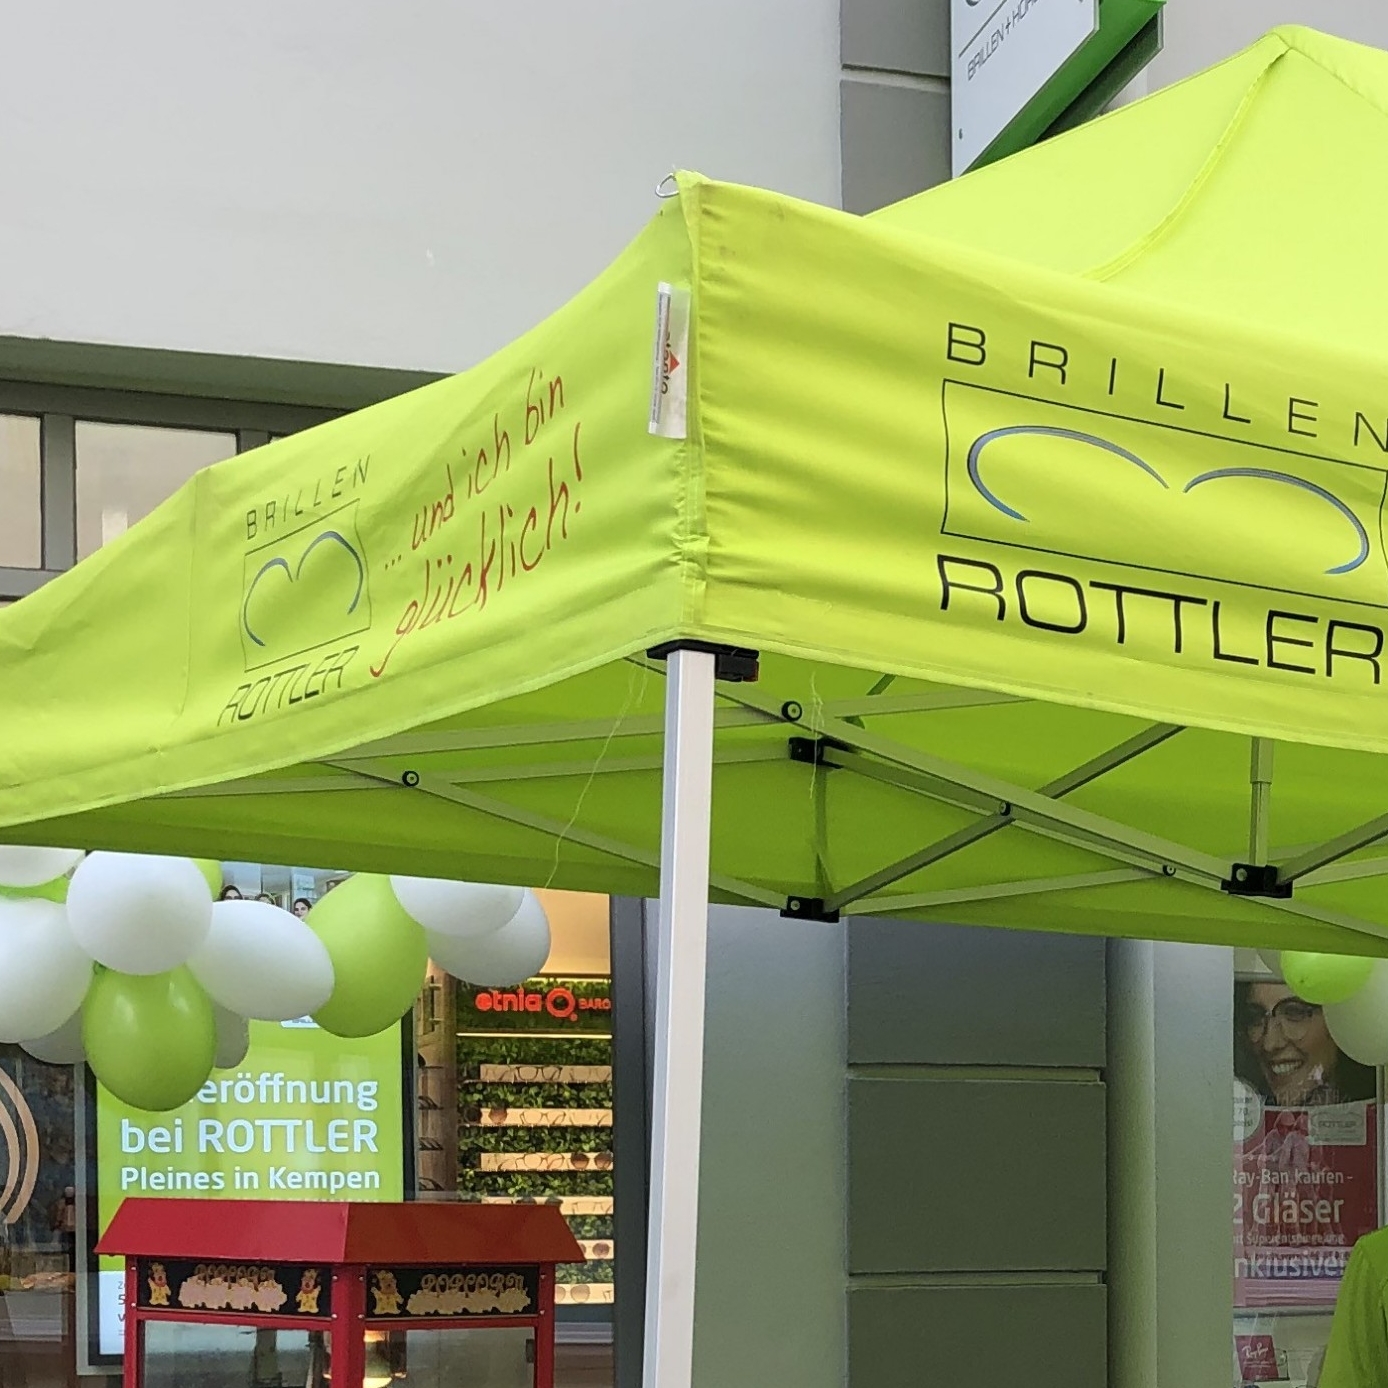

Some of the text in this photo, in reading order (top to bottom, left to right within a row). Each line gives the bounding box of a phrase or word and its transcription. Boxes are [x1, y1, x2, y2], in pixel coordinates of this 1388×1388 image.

[967, 23, 1005, 82] BRILLEN
[411, 463, 455, 551] und
[461, 412, 511, 500] ich
[524, 366, 565, 446] bin
[245, 454, 371, 540] BRILLEN
[369, 422, 583, 678] glücklich!
[937, 554, 1384, 685] ROTTLER
[217, 645, 360, 727] ROTTLER
[475, 986, 542, 1012] etnia
[190, 1072, 379, 1111] eröffnung
[121, 1118, 379, 1154] bei ROTTLER
[121, 1165, 381, 1194] Pleines in Kempen
[1252, 1191, 1345, 1225] Gläser
